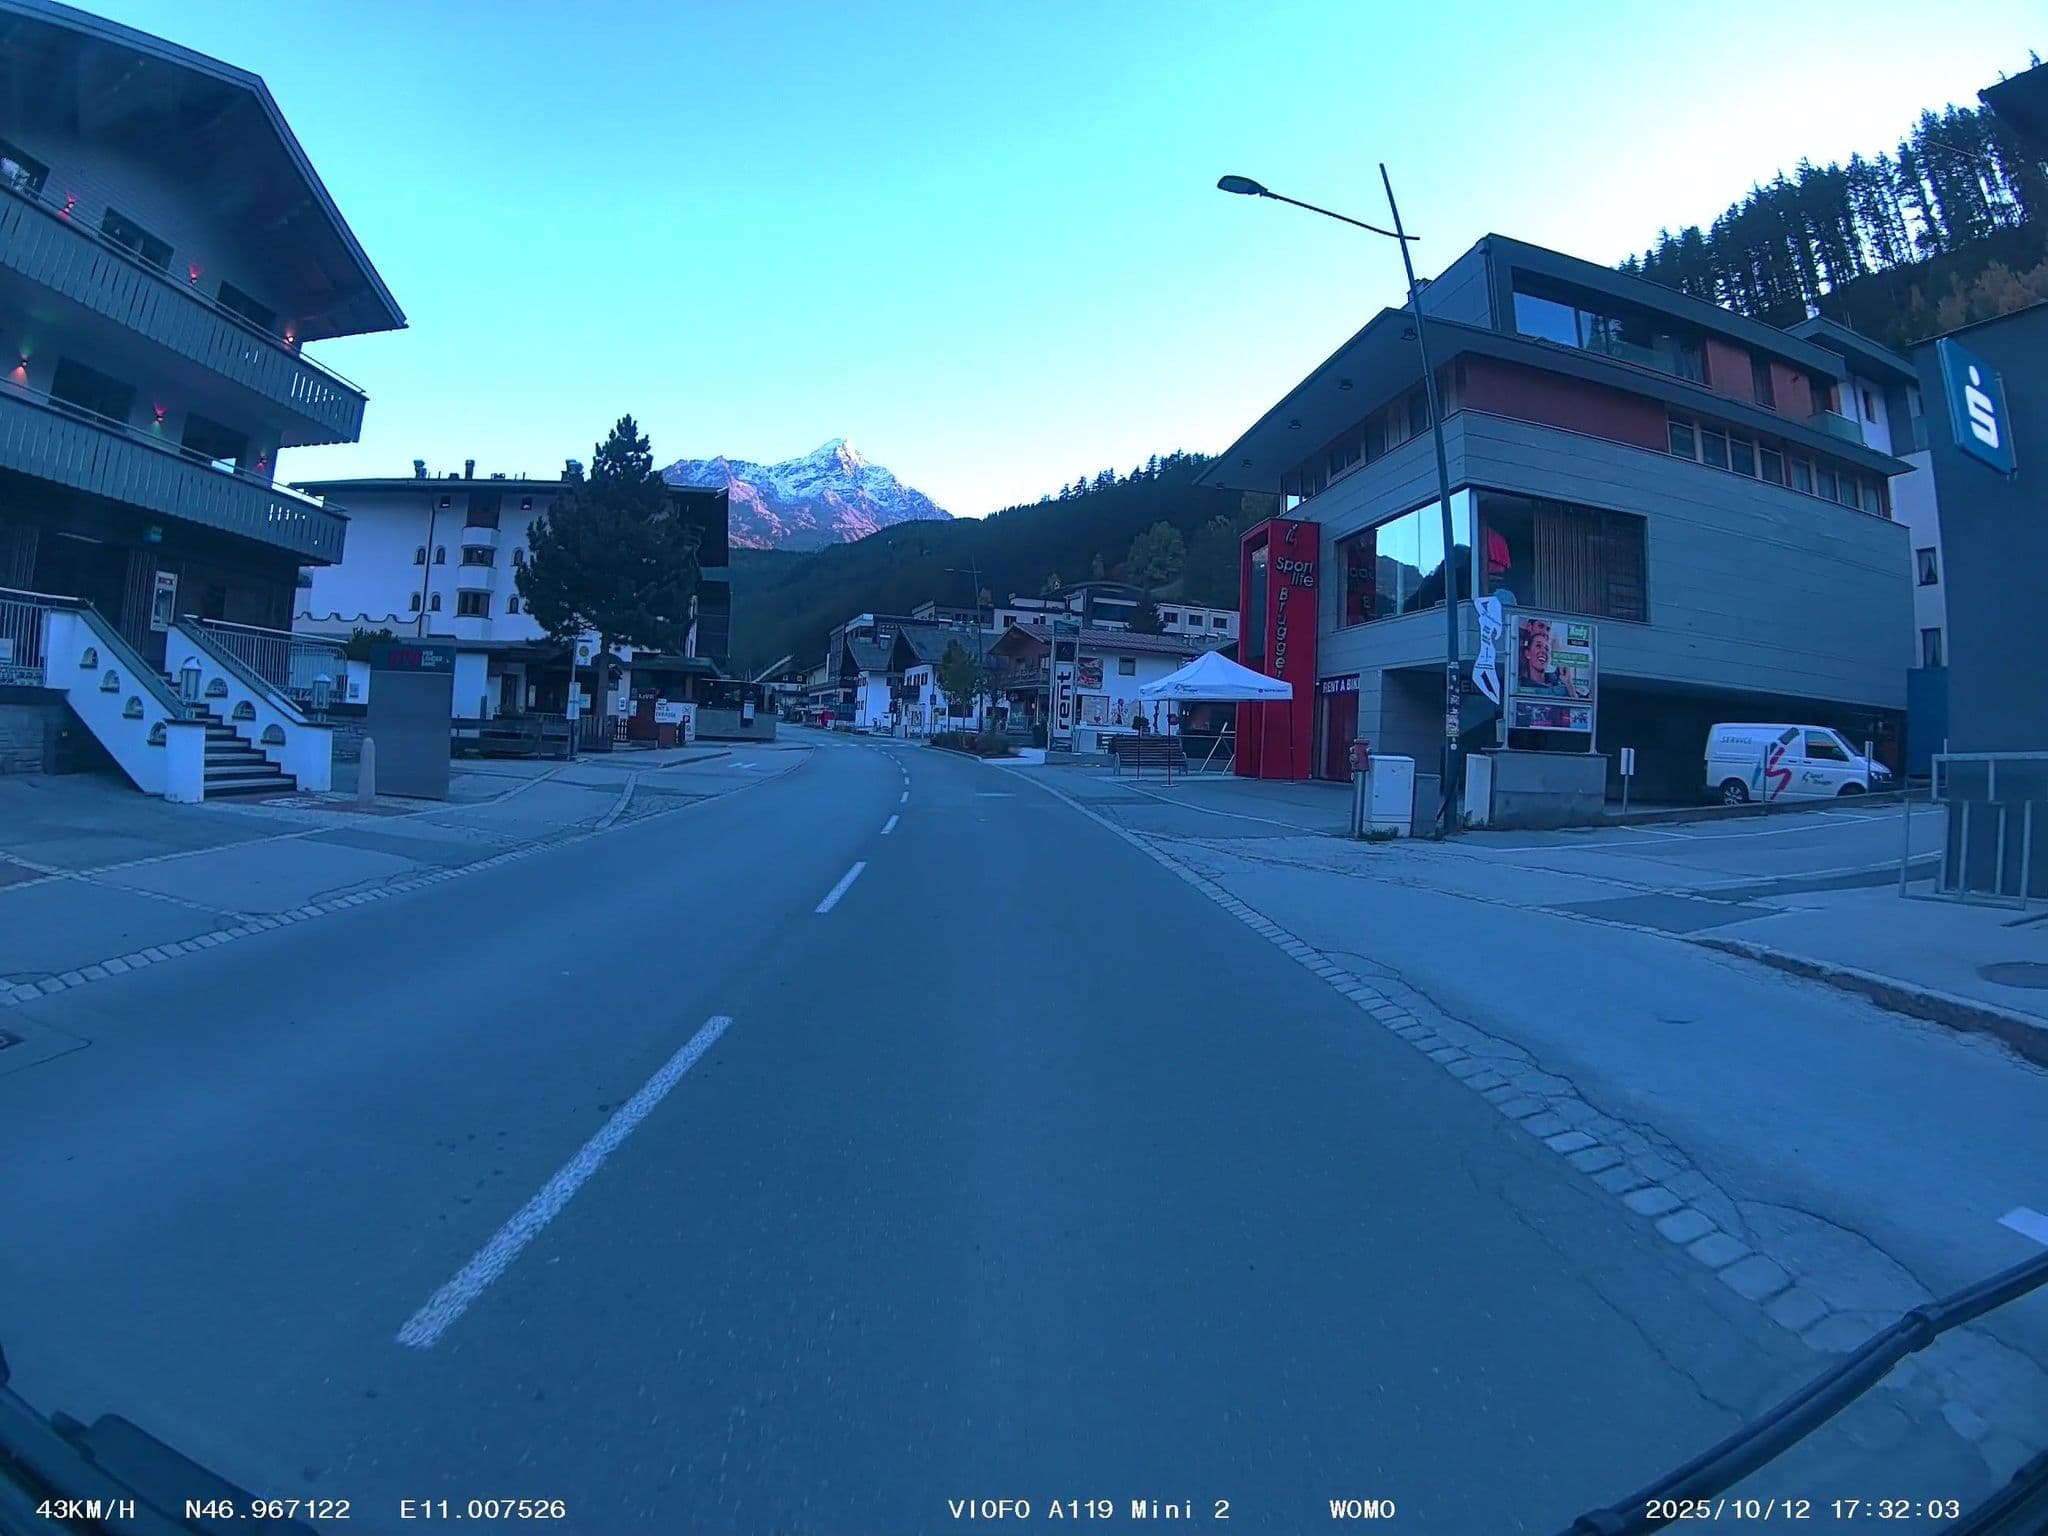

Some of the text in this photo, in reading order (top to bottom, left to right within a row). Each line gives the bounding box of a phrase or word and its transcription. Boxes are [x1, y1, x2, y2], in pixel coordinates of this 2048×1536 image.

[1056, 671, 1071, 730] rent
[1322, 680, 1339, 694] RENT
[1340, 679, 1346, 692] A
